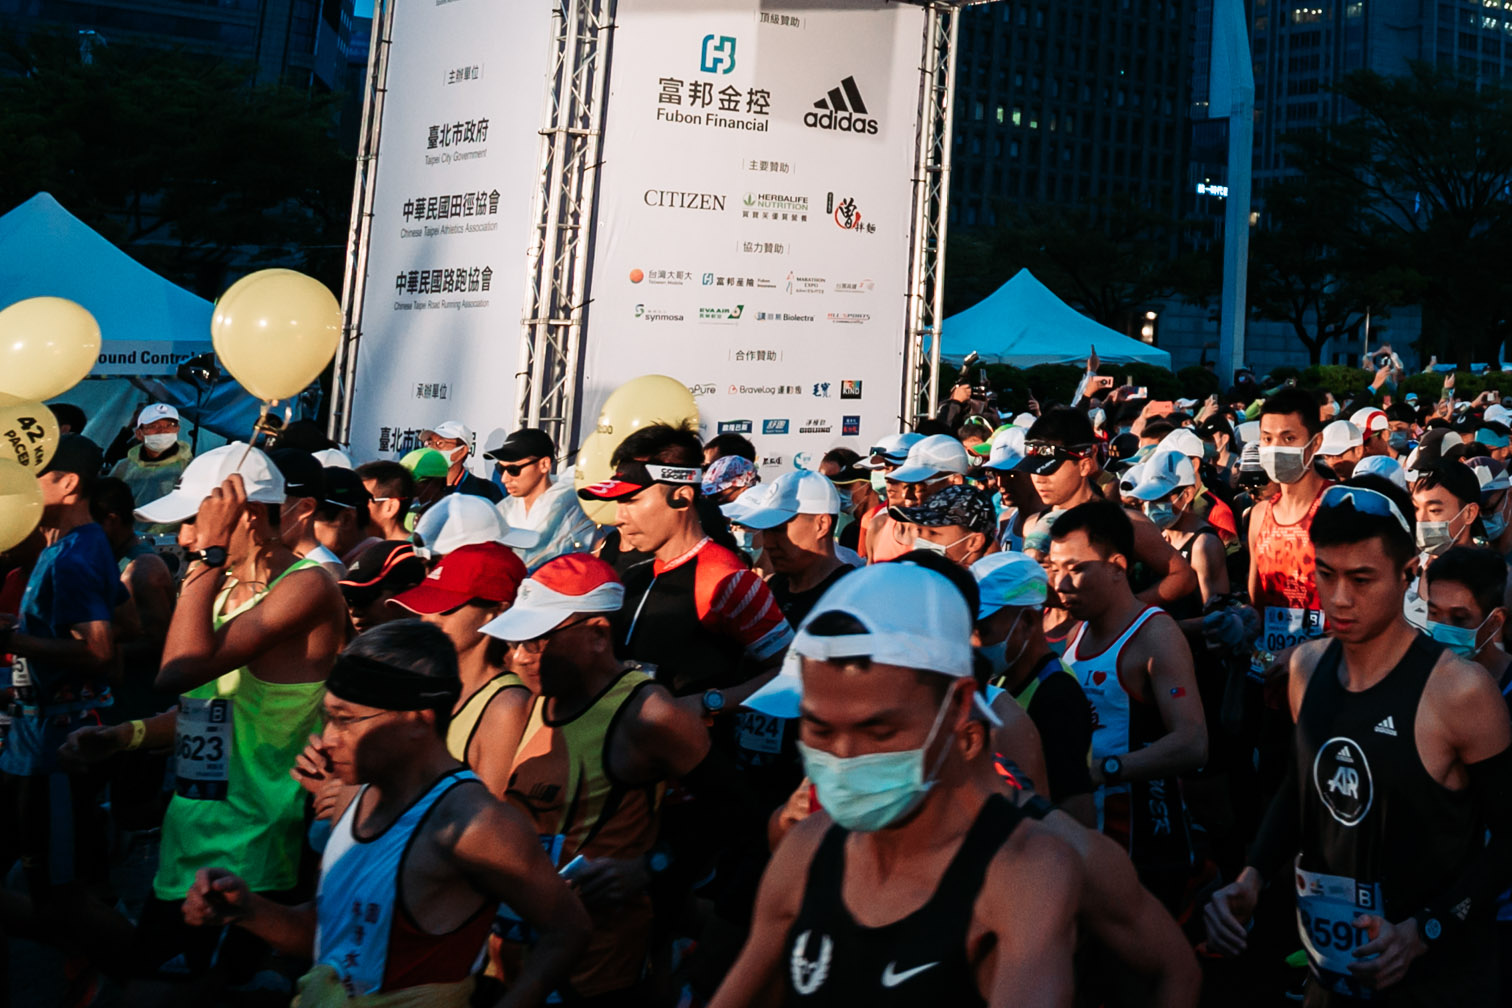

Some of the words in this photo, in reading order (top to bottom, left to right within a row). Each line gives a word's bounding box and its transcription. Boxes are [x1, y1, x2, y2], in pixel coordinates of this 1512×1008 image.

[759, 12, 800, 28] 頂級贊助
[448, 66, 479, 85] 主辦單位
[658, 77, 771, 116] 富邦金控
[657, 108, 702, 126] Fubon
[706, 113, 769, 132] Financial
[804, 109, 878, 135] adidas
[427, 117, 489, 150] 臺北市政府
[425, 154, 440, 166] Taipei
[441, 152, 452, 166] City
[453, 149, 488, 162] Government
[748, 160, 790, 174] 主要贊助
[402, 189, 501, 223] 中華民國田徑協會
[644, 189, 727, 211] CITIZEN
[758, 193, 808, 204] HERBALIFE
[758, 201, 808, 211] NUTRITION
[401, 226, 423, 239] Chinese
[424, 225, 440, 239] Taipei
[440, 223, 464, 235] Athletics
[466, 221, 498, 233] Association
[743, 241, 784, 255] 協力贊助
[395, 266, 493, 296] 中華民國路跑協會
[649, 270, 692, 280] 台灣大哥大
[428, 300, 440, 310] Road
[645, 313, 684, 323] synmosa
[783, 313, 815, 322] Biolectra
[98, 351, 136, 364] ound
[140, 351, 195, 364] Contr
[735, 349, 777, 362] 合作贊助
[17, 417, 45, 444] 42
[1358, 890, 1372, 908] B
